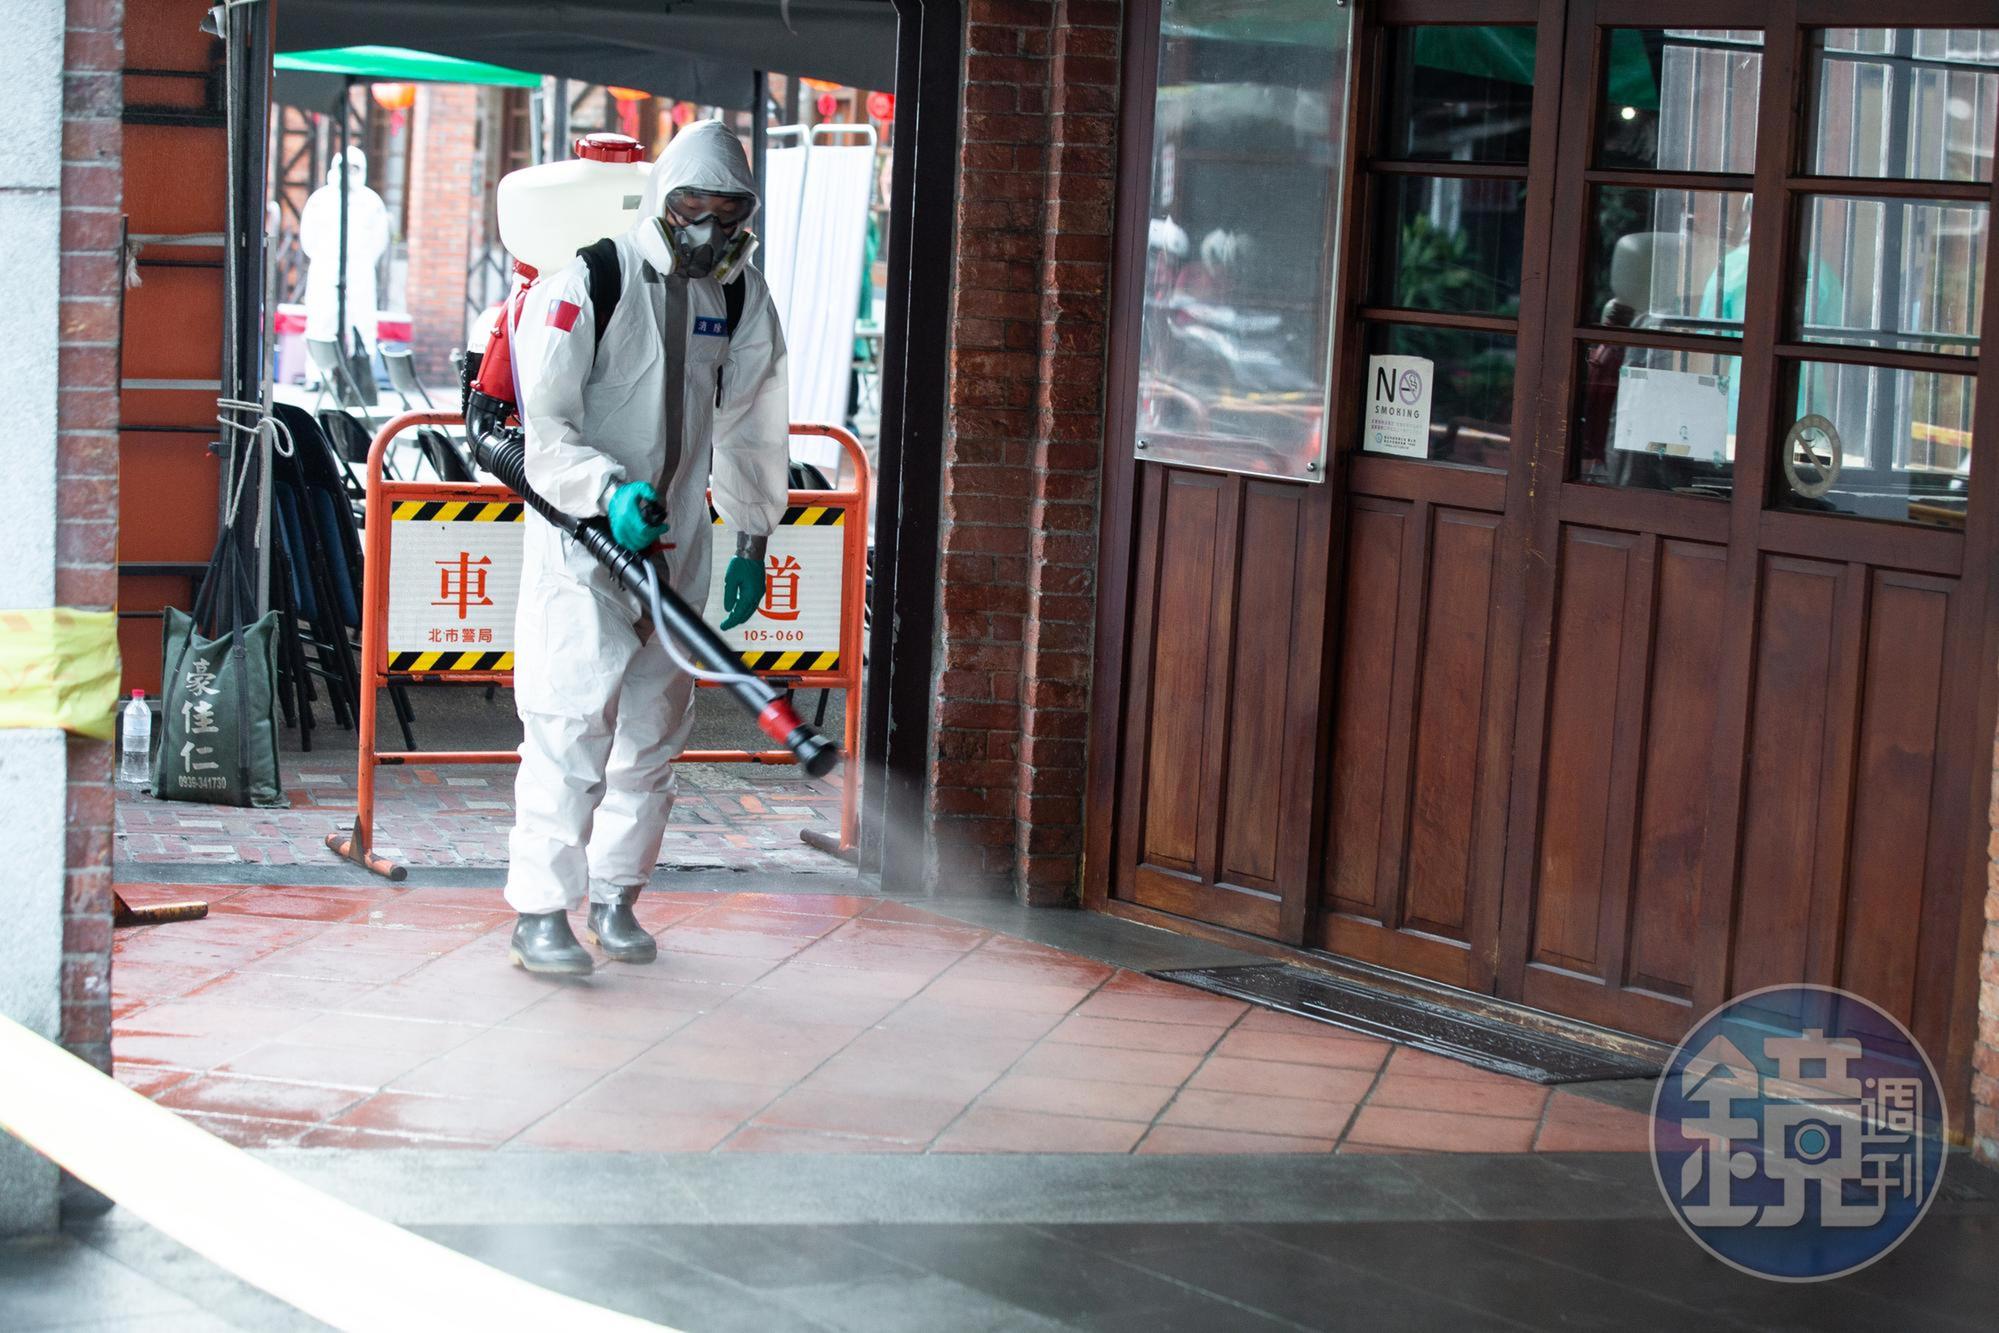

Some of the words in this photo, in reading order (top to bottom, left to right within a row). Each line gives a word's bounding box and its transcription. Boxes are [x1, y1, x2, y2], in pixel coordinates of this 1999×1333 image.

[1375, 405, 1420, 418] SMOKING
[431, 551, 494, 620] 車
[428, 628, 493, 643] 北市警局
[743, 630, 804, 641] 105-060
[180, 657, 221, 774] 豪佳仁
